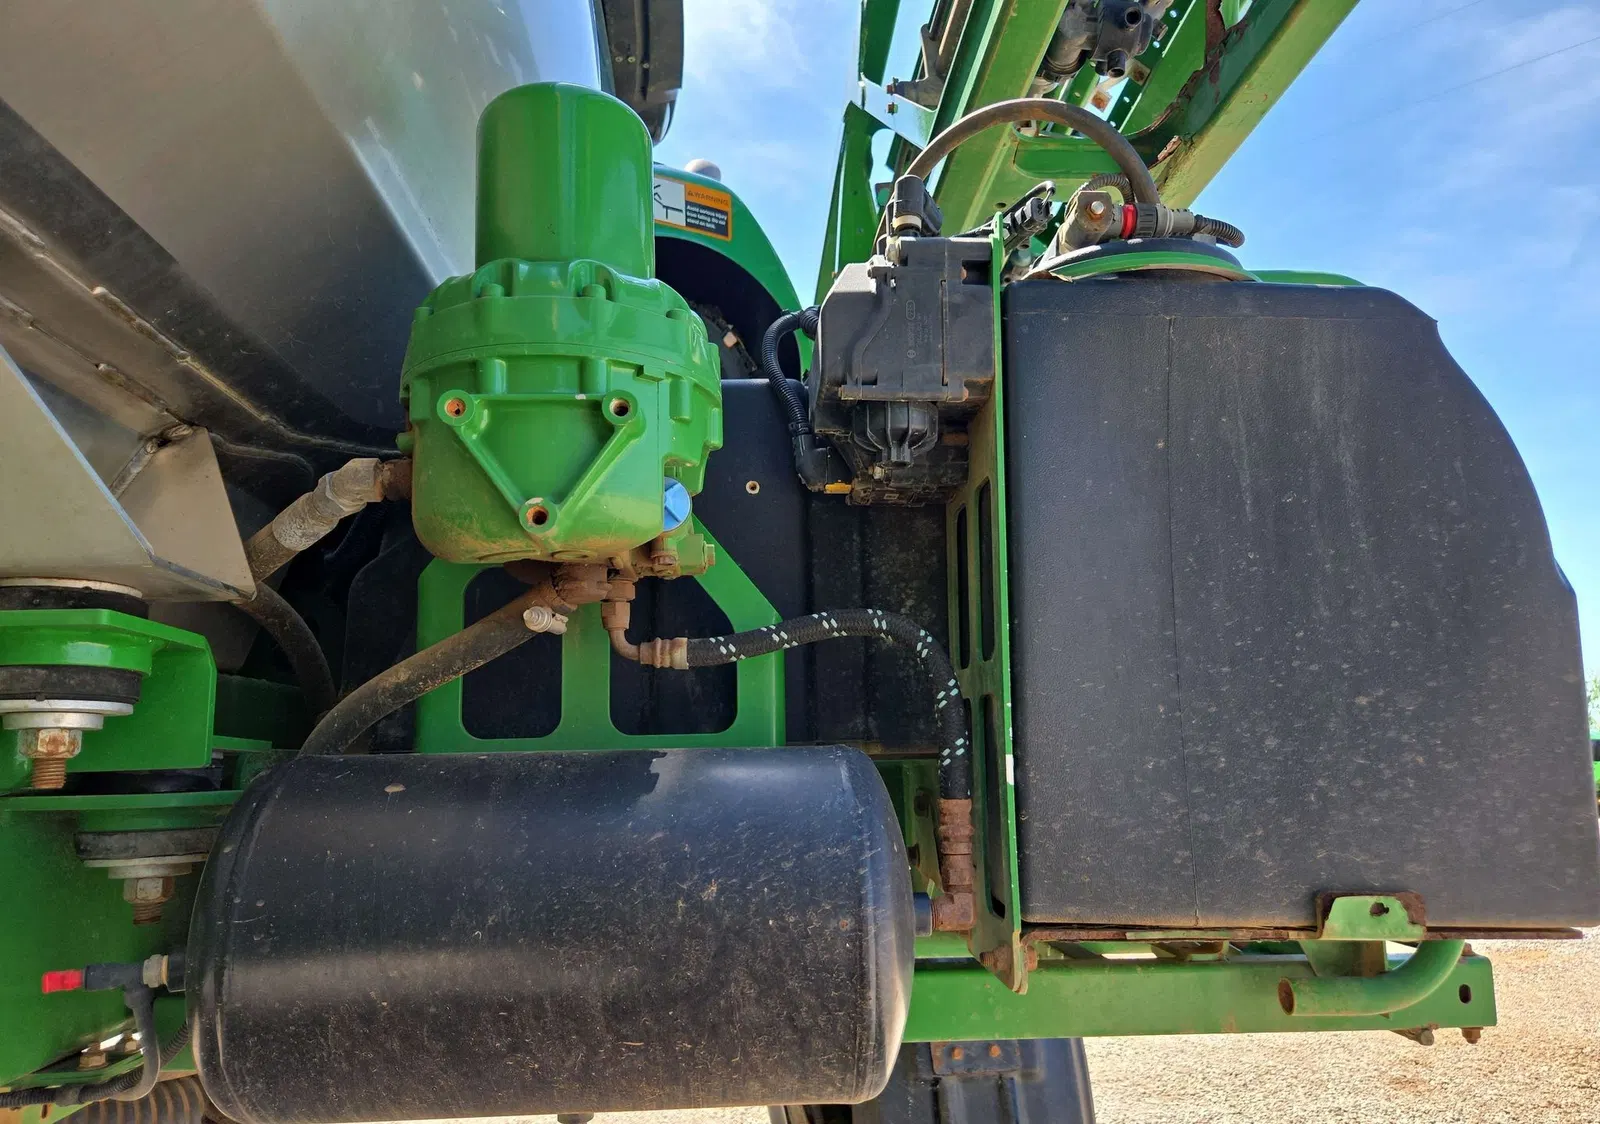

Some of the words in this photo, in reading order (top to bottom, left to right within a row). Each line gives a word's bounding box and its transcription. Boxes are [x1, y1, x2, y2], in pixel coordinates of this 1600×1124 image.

[695, 191, 728, 205] WARNING
[700, 208, 715, 217] serious
[715, 213, 727, 221] injury
